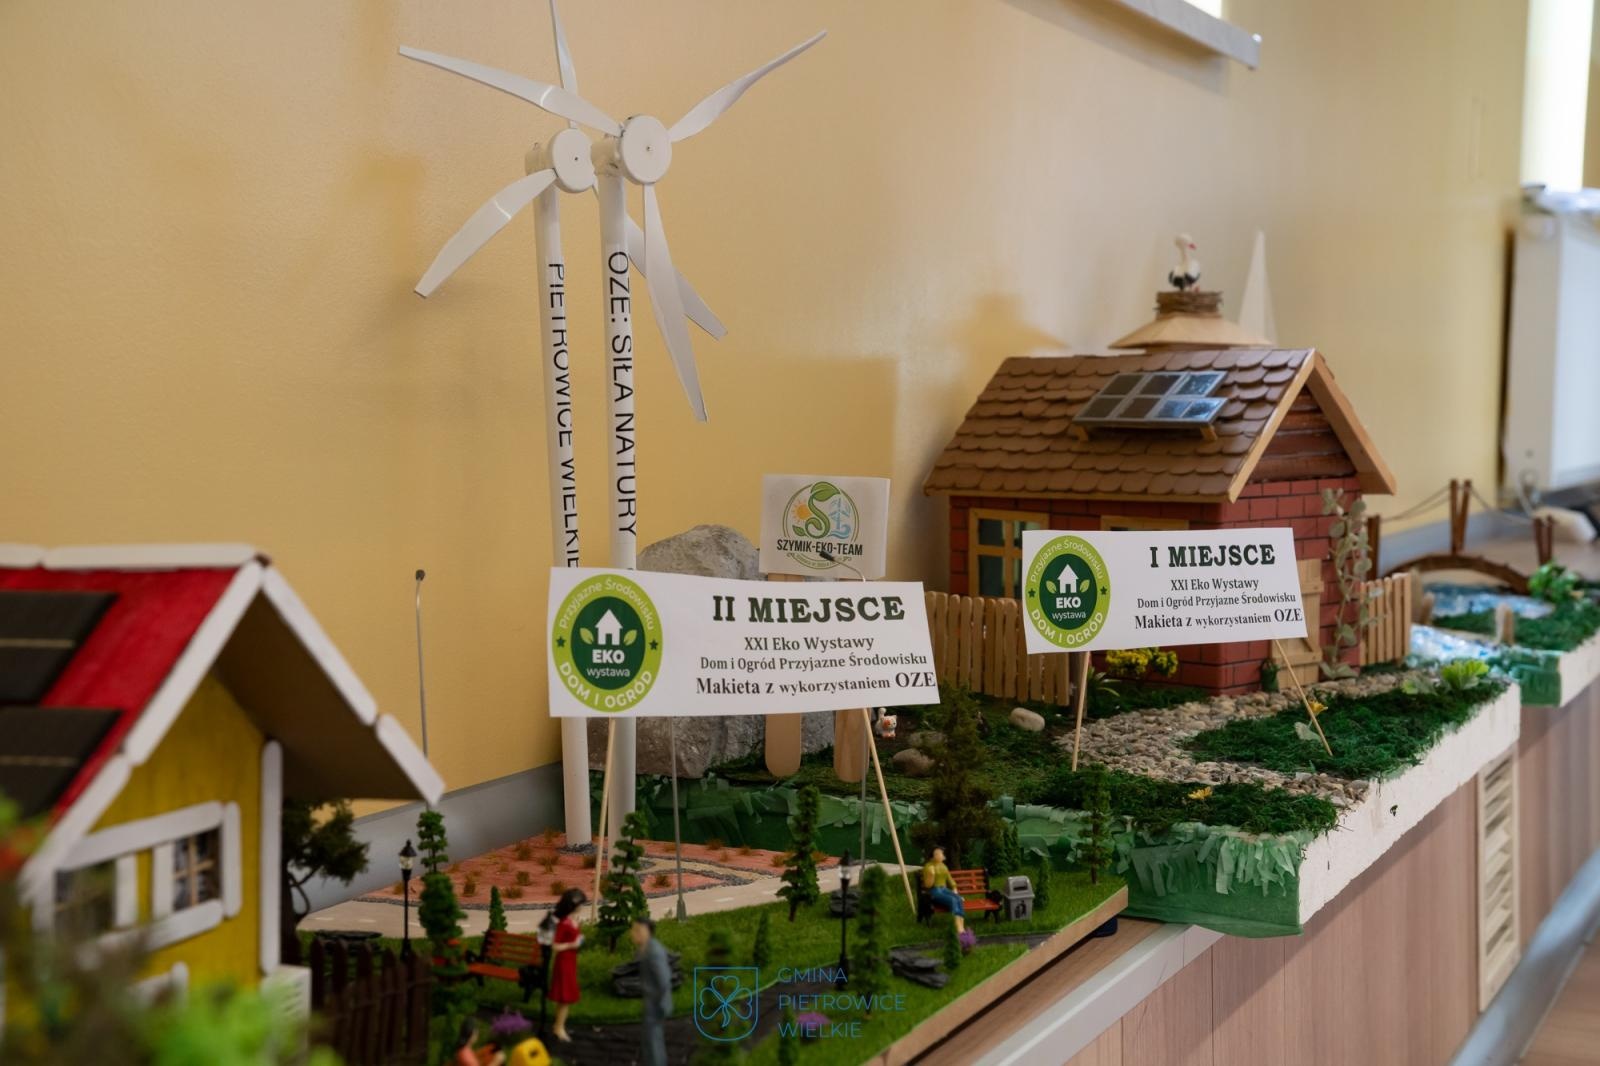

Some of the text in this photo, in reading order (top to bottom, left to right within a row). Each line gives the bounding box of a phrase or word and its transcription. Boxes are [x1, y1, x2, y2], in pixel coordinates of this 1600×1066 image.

[548, 263, 573, 448] PIETROWICE
[608, 251, 637, 537] OZE: SIŁA NATURY
[776, 538, 863, 556] SZYMIK-EKO-TEAM
[1149, 544, 1275, 568] I MIEJSCE
[1030, 538, 1104, 583] Przyjazne Środowisku
[1170, 577, 1259, 593] XXI Eko Wystawy
[559, 576, 654, 630] Przyjazne Środowisku
[712, 595, 905, 623] II MIEJSCE
[1055, 596, 1082, 609] EKO
[1137, 591, 1296, 610] Dom i Ogród Przyjazne Środowisku
[1031, 608, 1057, 640] DOM
[1058, 633, 1063, 643] I
[1051, 610, 1087, 622] wystawa
[1135, 608, 1303, 629] Makieta z wykorzystaniem OZE
[744, 636, 874, 653] XXI Eko Wystawy
[591, 649, 626, 664] EKO
[700, 652, 928, 673] Dom i Ogród Przyjazne Środowisku
[559, 661, 591, 701] DOM
[594, 693, 600, 706] I
[586, 667, 631, 679] wystawa
[696, 671, 936, 696] Makieta z wykorzystaniem OZE
